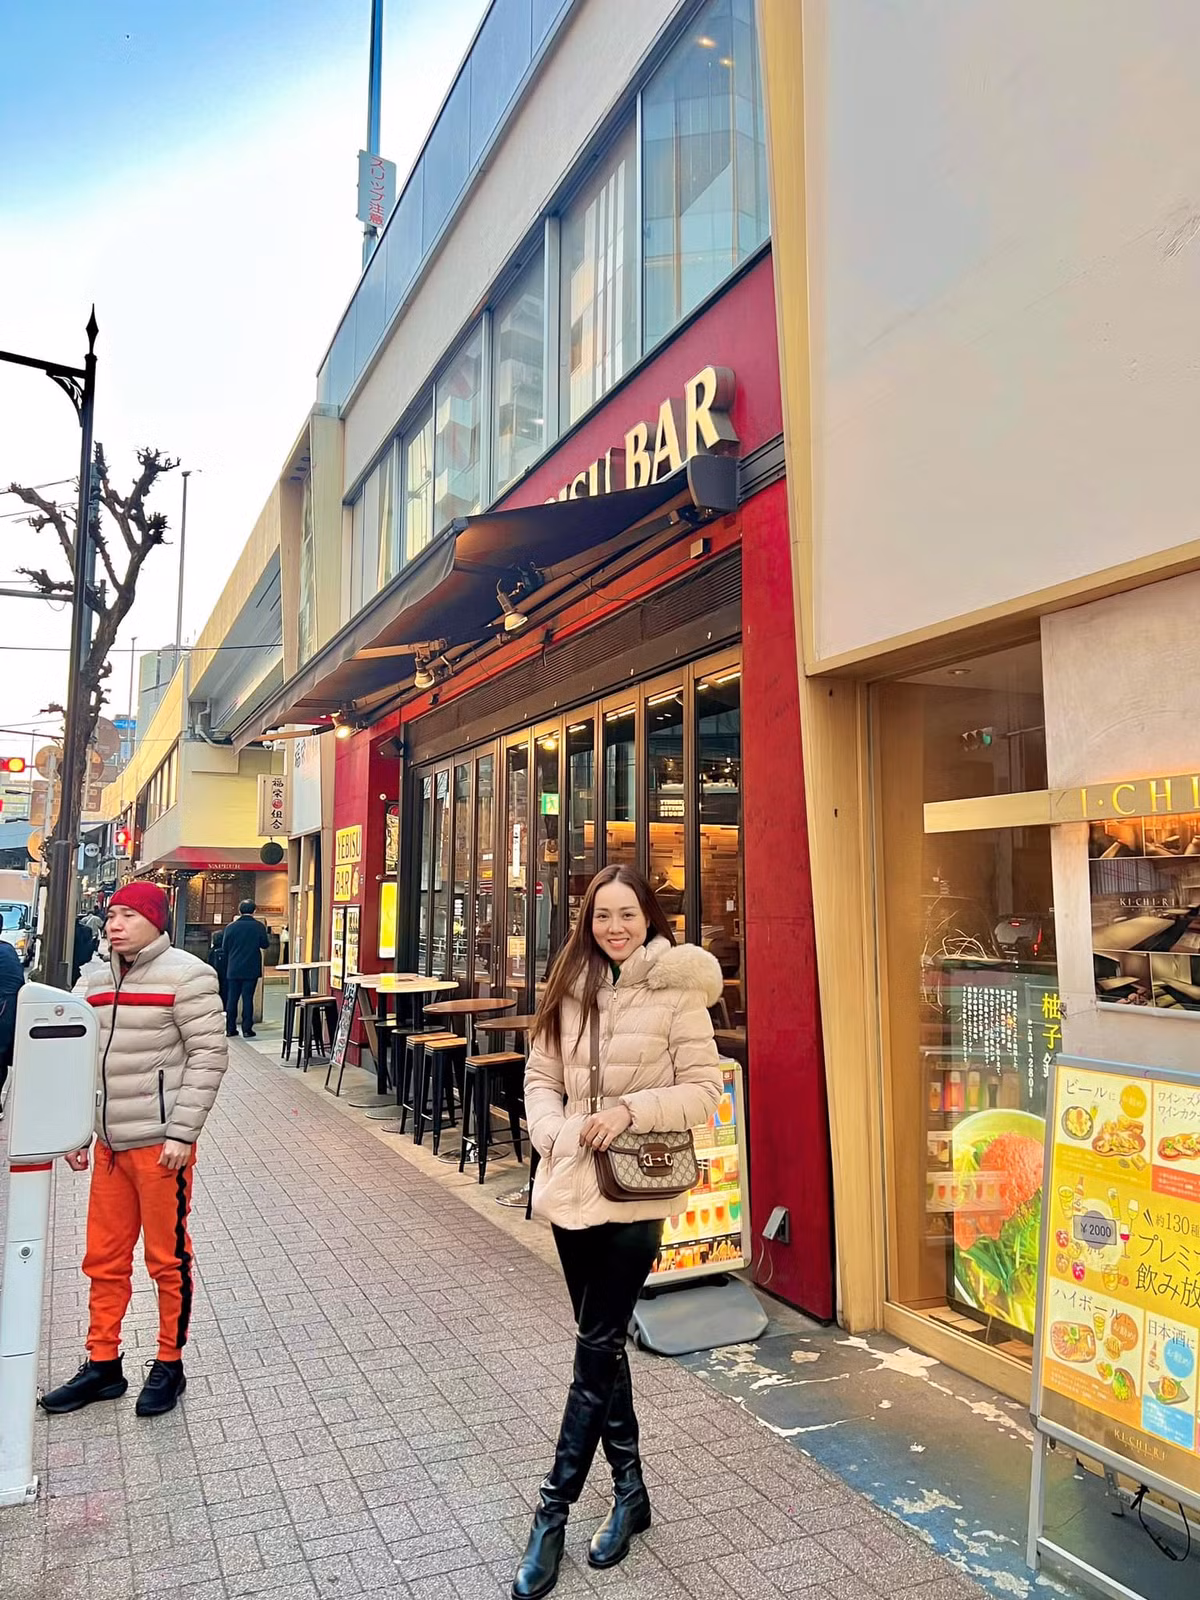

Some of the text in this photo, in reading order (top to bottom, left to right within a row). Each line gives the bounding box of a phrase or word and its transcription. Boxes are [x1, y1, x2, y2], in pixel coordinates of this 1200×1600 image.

[624, 365, 722, 490] BAR
[337, 831, 361, 860] YEBISU
[335, 870, 350, 895] BAR
[1065, 1079, 1117, 1101] ビールに
